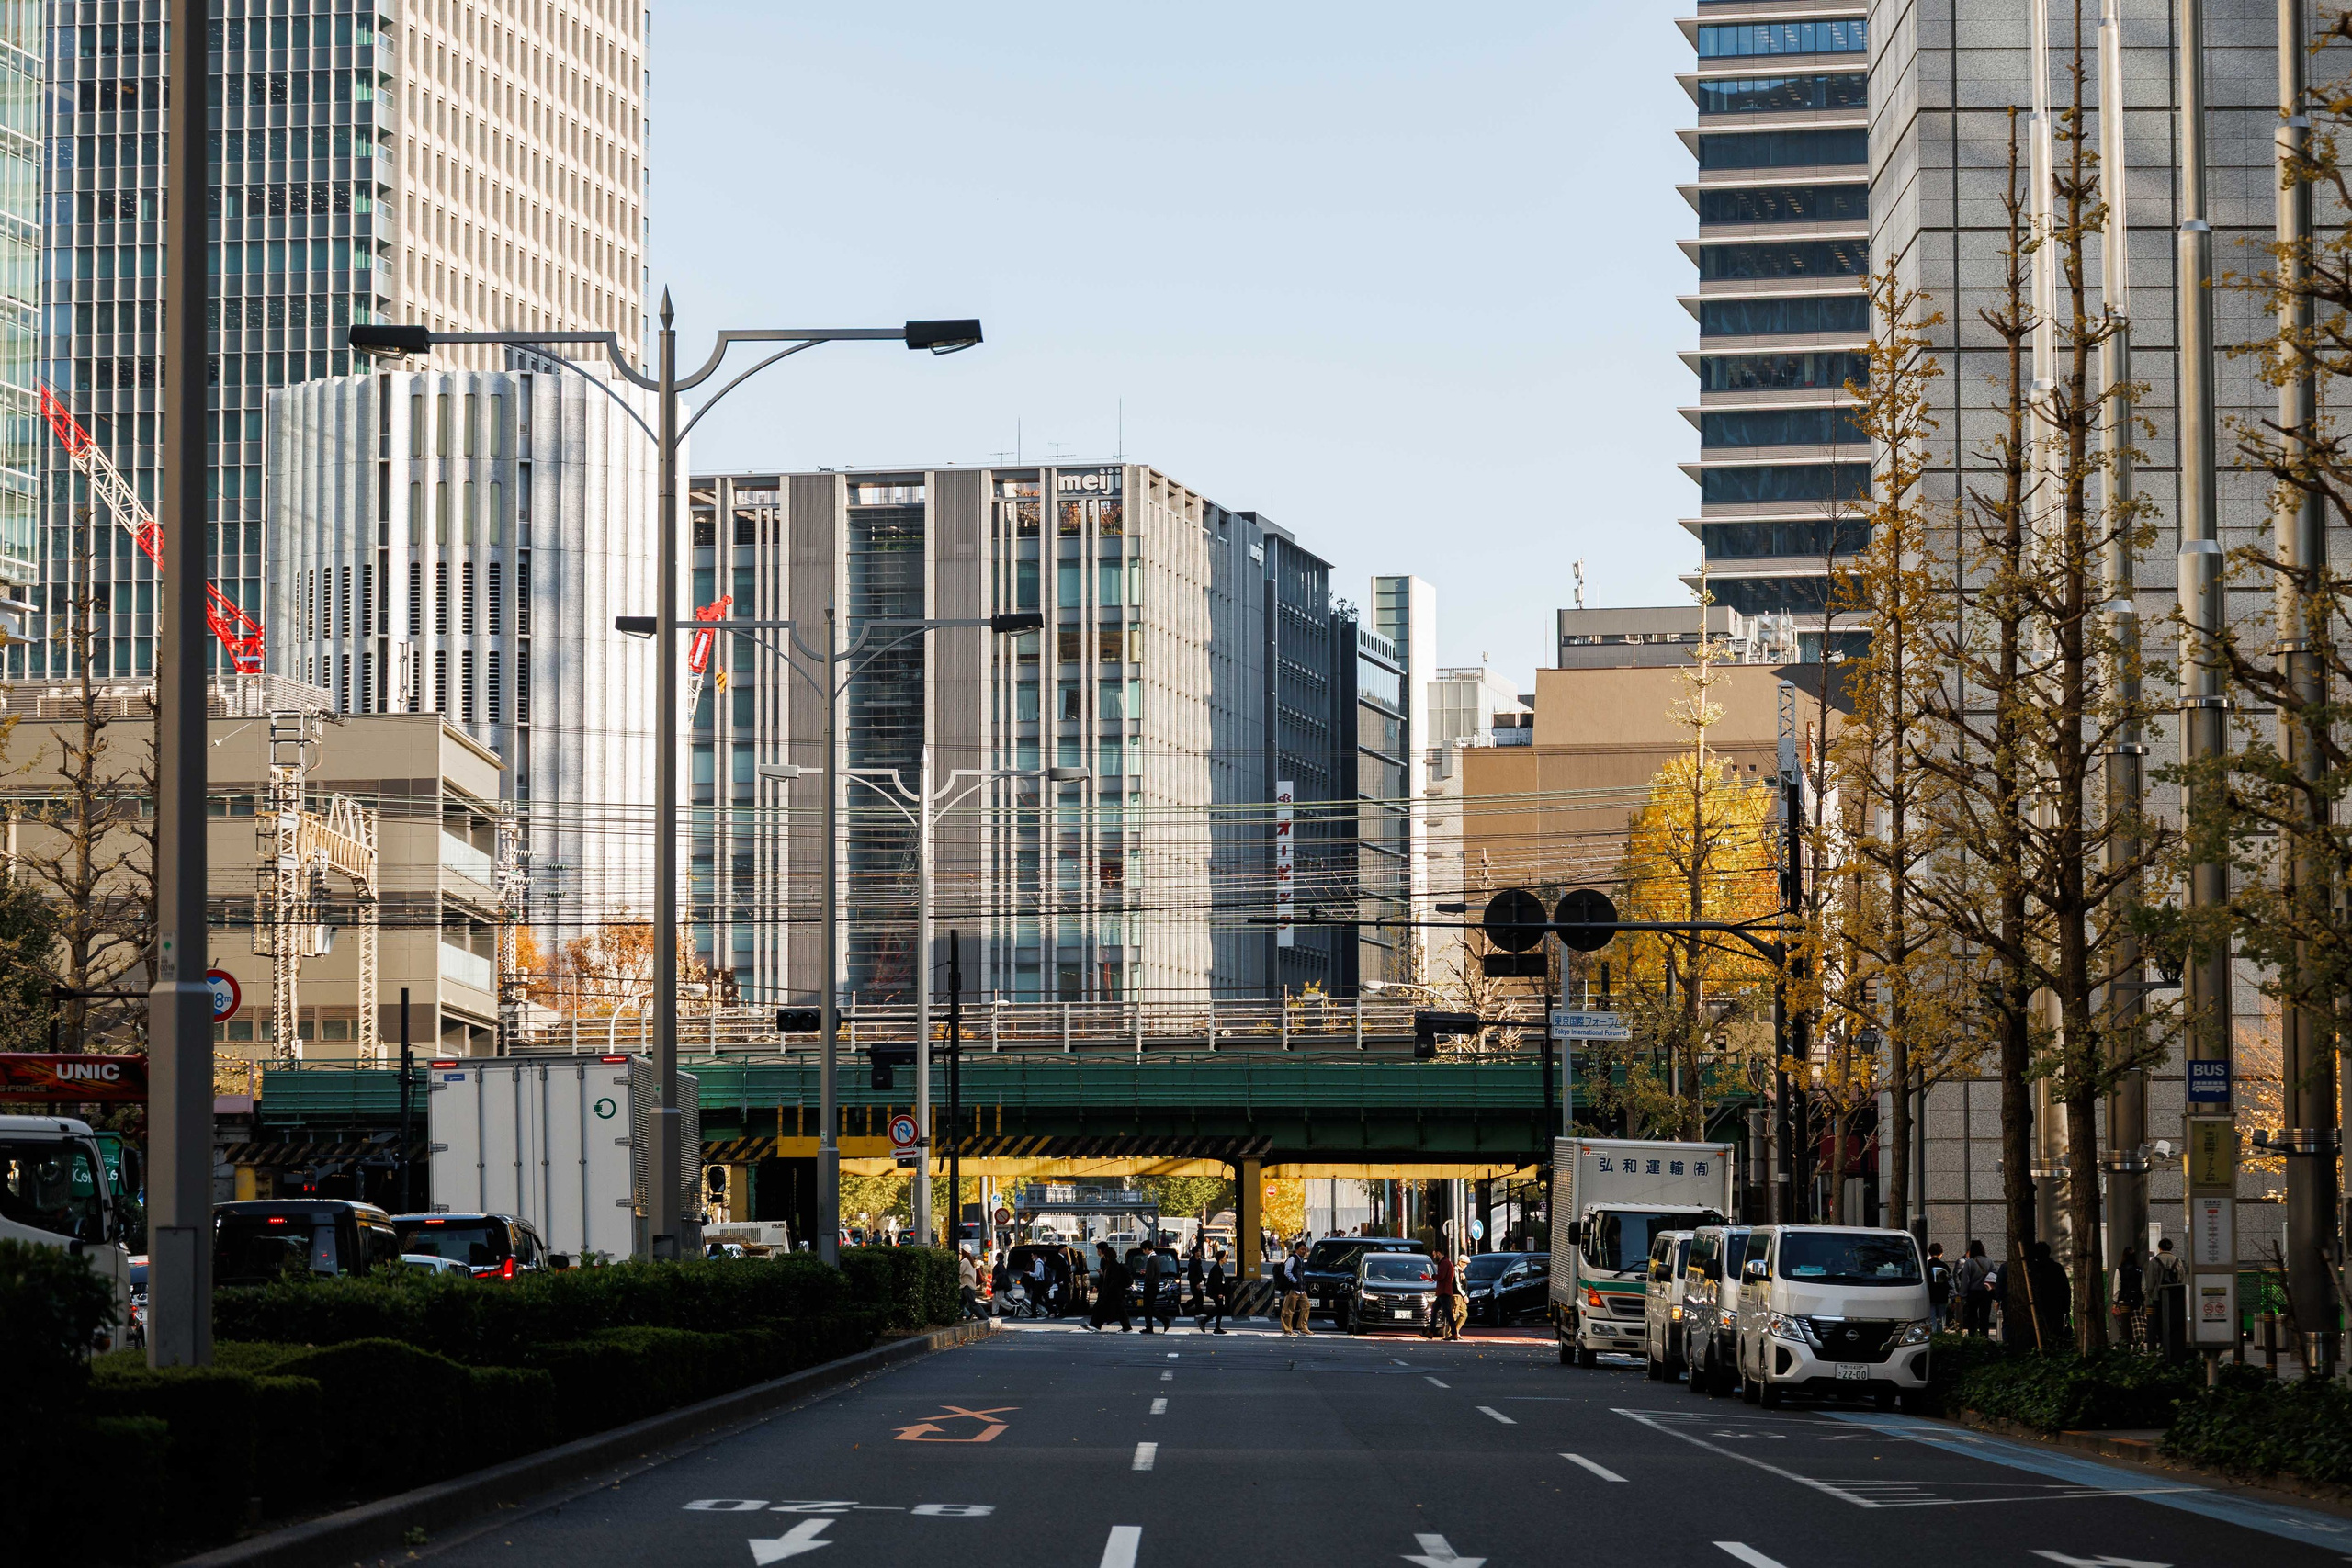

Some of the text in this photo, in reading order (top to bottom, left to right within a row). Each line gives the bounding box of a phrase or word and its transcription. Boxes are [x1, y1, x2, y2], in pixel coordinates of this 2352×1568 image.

[1057, 468, 1122, 494] meiji
[56, 1063, 119, 1080] UNIC
[2193, 1064, 2225, 1077] BUS
[1842, 1370, 1866, 1380] 22-00
